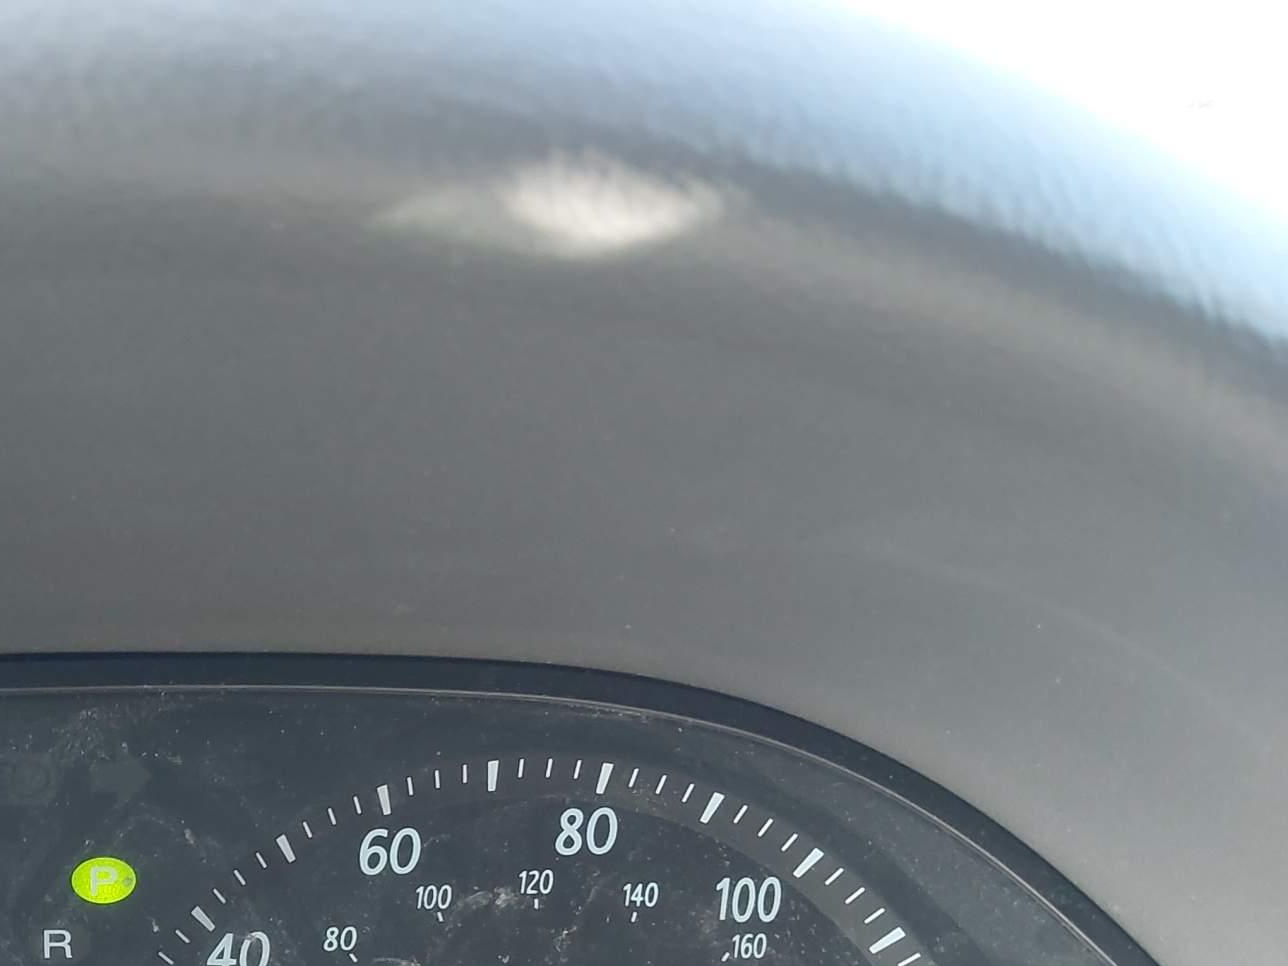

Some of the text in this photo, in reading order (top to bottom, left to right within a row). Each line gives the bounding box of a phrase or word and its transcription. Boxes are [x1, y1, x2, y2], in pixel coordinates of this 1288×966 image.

[554, 807, 618, 855] 80
[359, 828, 421, 875] 60
[89, 866, 118, 896] P
[519, 869, 554, 895] 120
[415, 884, 452, 910] 100
[623, 882, 659, 908] 140
[715, 877, 782, 923] 100
[43, 929, 73, 958] R
[323, 926, 358, 951] 80
[731, 933, 767, 959] 160
